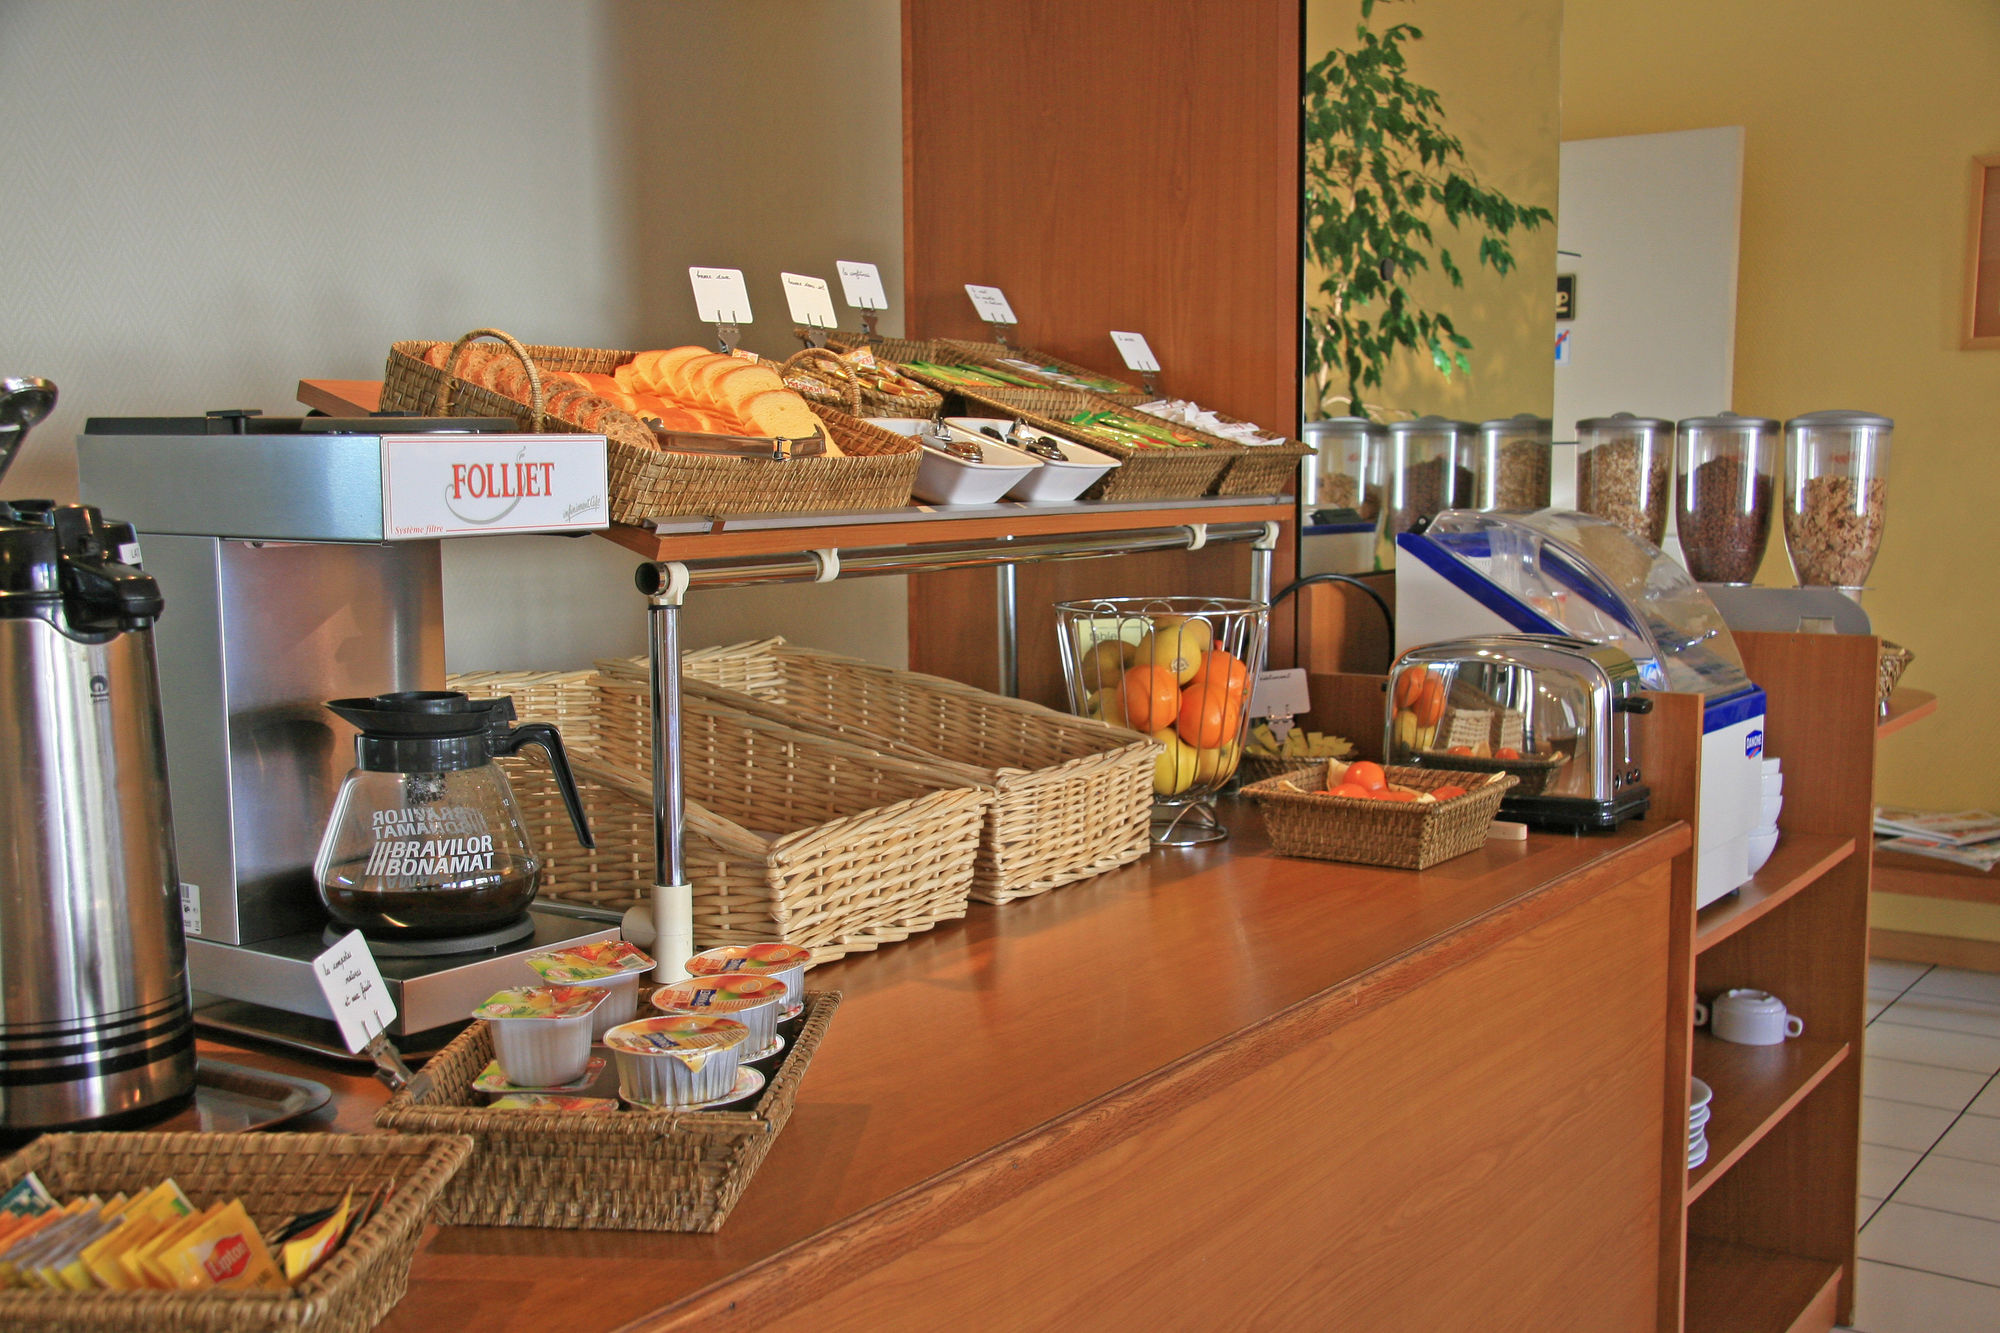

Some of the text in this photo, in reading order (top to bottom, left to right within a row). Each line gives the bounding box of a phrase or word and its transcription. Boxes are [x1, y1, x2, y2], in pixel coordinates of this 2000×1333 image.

[451, 462, 555, 500] FOLLIET
[390, 834, 494, 858] BRAVILOR
[385, 852, 495, 876] BONAMAT
[207, 1241, 247, 1276] Lipton
